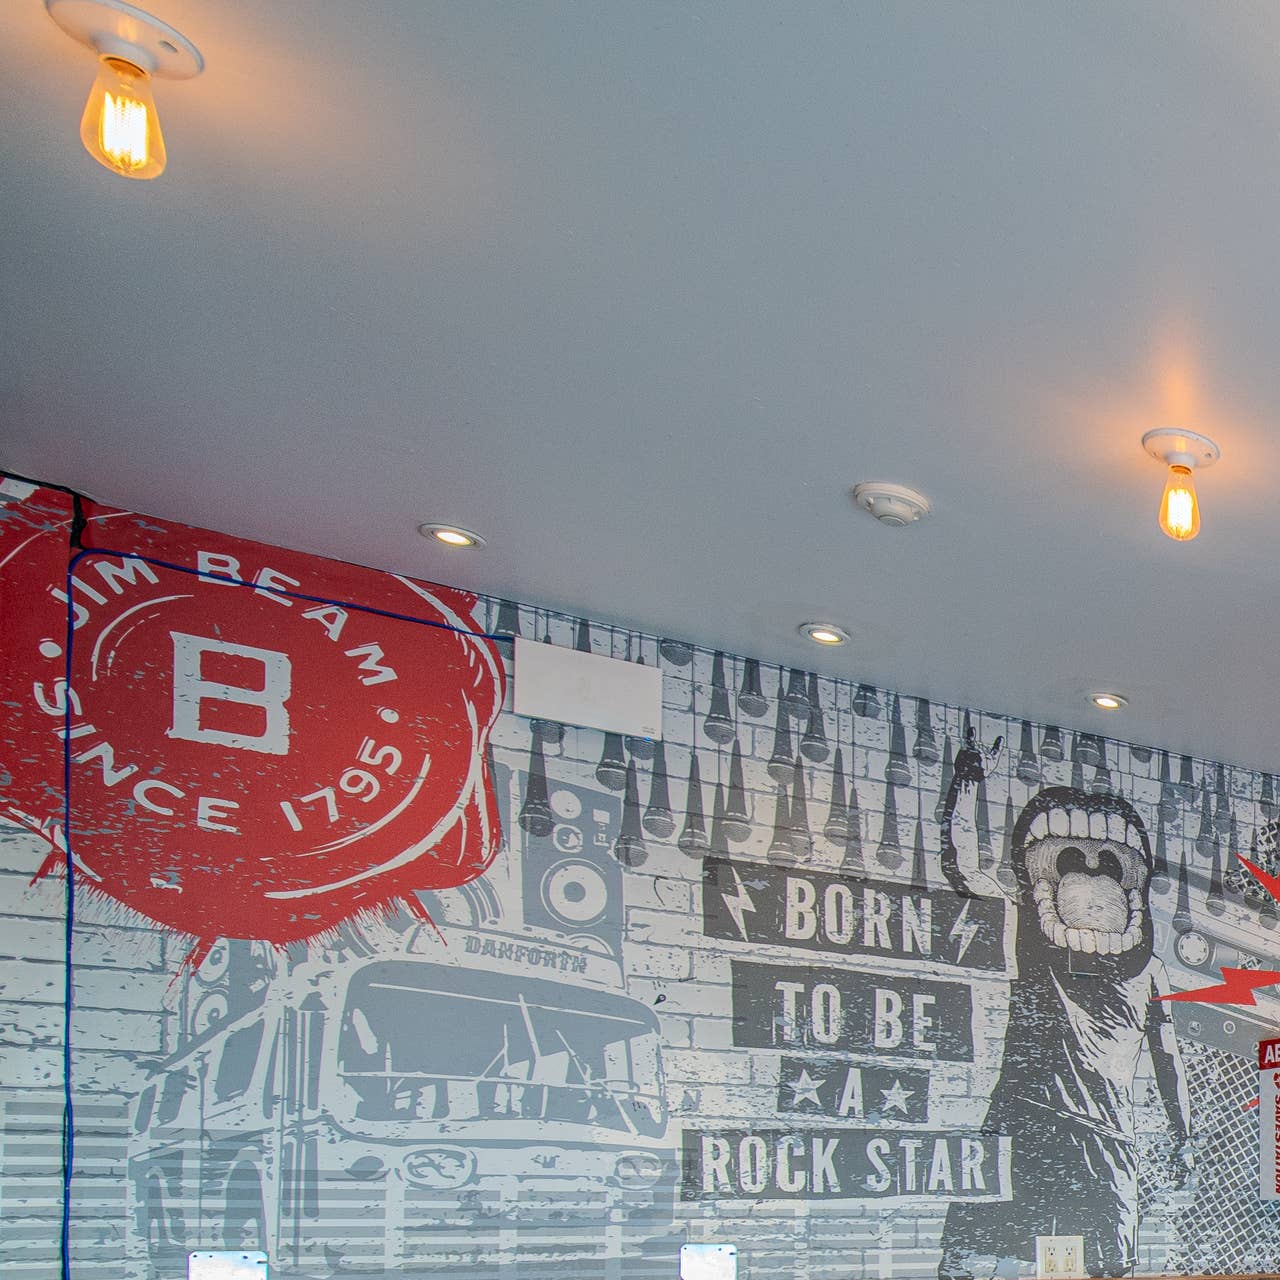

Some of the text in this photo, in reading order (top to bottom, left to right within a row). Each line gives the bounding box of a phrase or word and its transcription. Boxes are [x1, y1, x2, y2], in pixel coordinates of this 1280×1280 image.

[46, 551, 397, 686] JIM BEAM
[166, 630, 291, 755] B
[34, 681, 403, 833] SINCE 1795
[785, 877, 932, 955] BORN
[463, 935, 588, 974] DANFORTH
[775, 982, 937, 1051] TO BE
[838, 1068, 864, 1118] A
[701, 1134, 986, 1194] ROCK STAR
